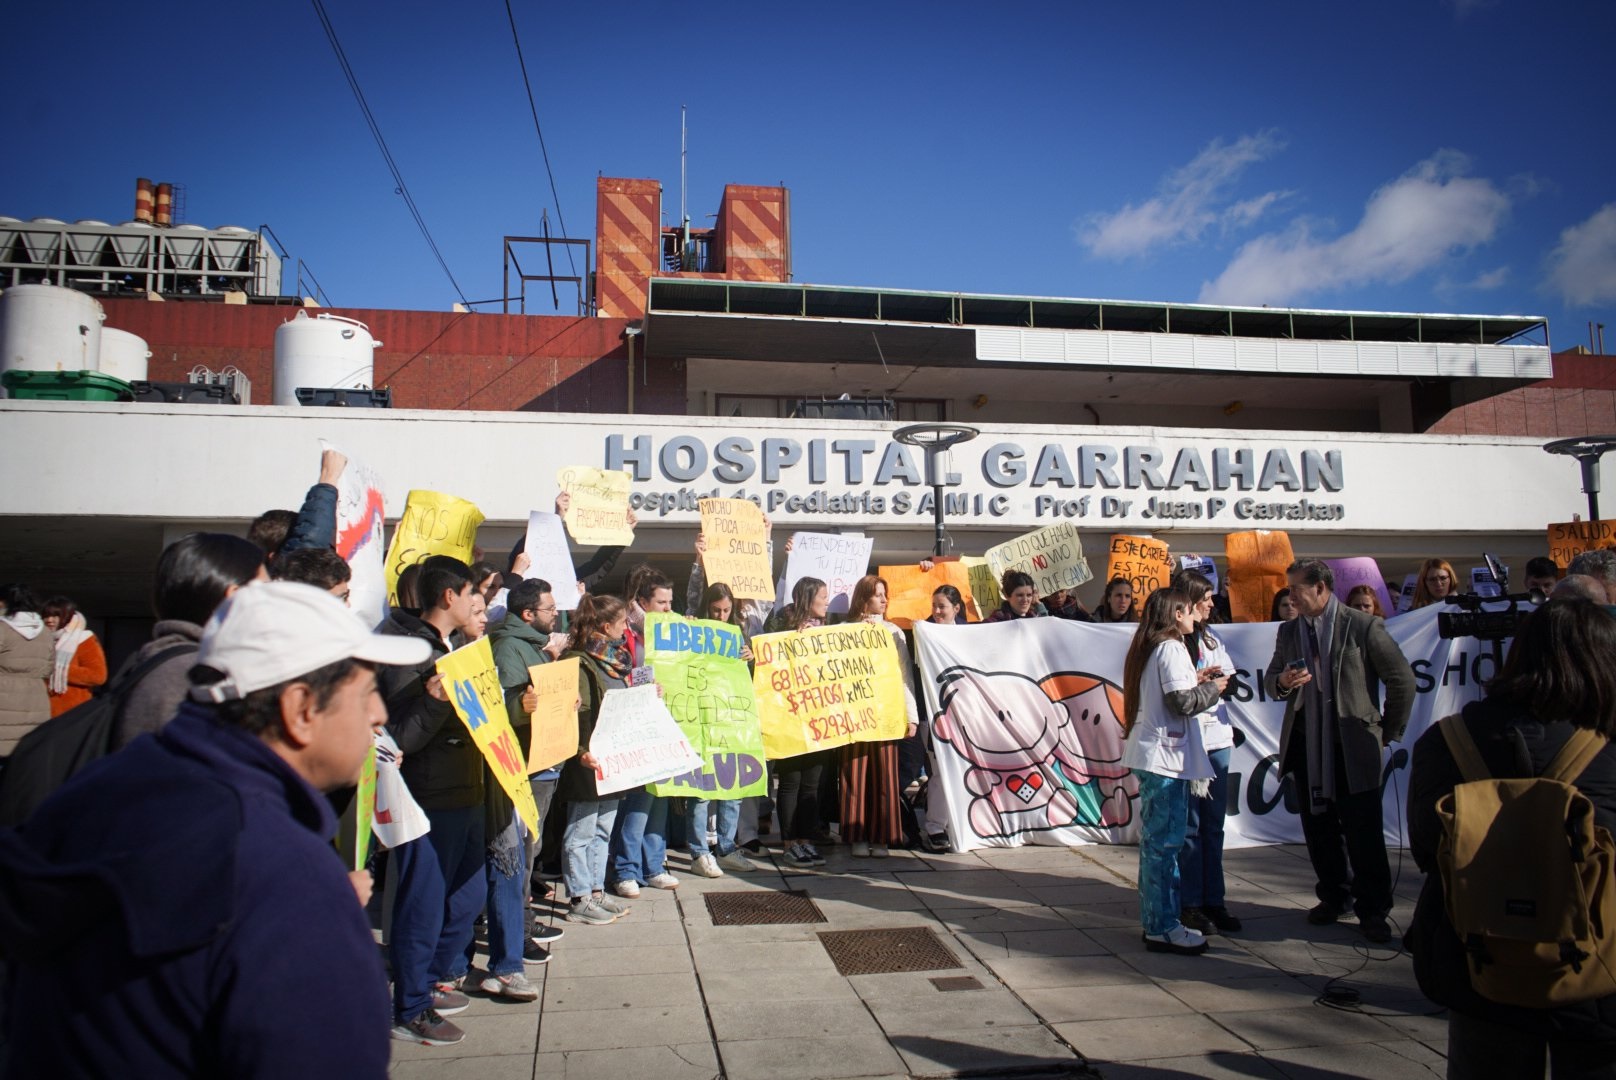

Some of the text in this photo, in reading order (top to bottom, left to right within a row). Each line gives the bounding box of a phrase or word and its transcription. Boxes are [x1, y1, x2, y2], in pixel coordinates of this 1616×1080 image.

[981, 443, 1344, 492] GARRAHAN
[629, 487, 720, 517] ospit
[1036, 495, 1090, 519] Prof
[1101, 495, 1132, 518] Dr
[1142, 496, 1202, 519] Juan
[1208, 497, 1227, 519] P
[1234, 498, 1344, 521] Garrahan
[700, 500, 732, 515] MUCHO
[404, 505, 449, 541] NOS
[715, 517, 739, 534] POCA
[1555, 523, 1611, 540] SALUD
[728, 538, 762, 555] SALUD
[1017, 539, 1031, 557] LO
[1030, 531, 1050, 551] QUE
[1050, 521, 1074, 546] HAGO
[815, 555, 830, 569] TU
[1032, 554, 1048, 572] NO
[1046, 543, 1071, 564] VIVO
[731, 575, 768, 594] APAGA
[755, 624, 888, 666] 10 AÑOS DE FORMACIÓN
[687, 665, 708, 691] ES
[771, 669, 791, 692] 68
[793, 664, 812, 686] HS
[827, 656, 876, 681] SEMANA
[655, 752, 764, 791] LUD
